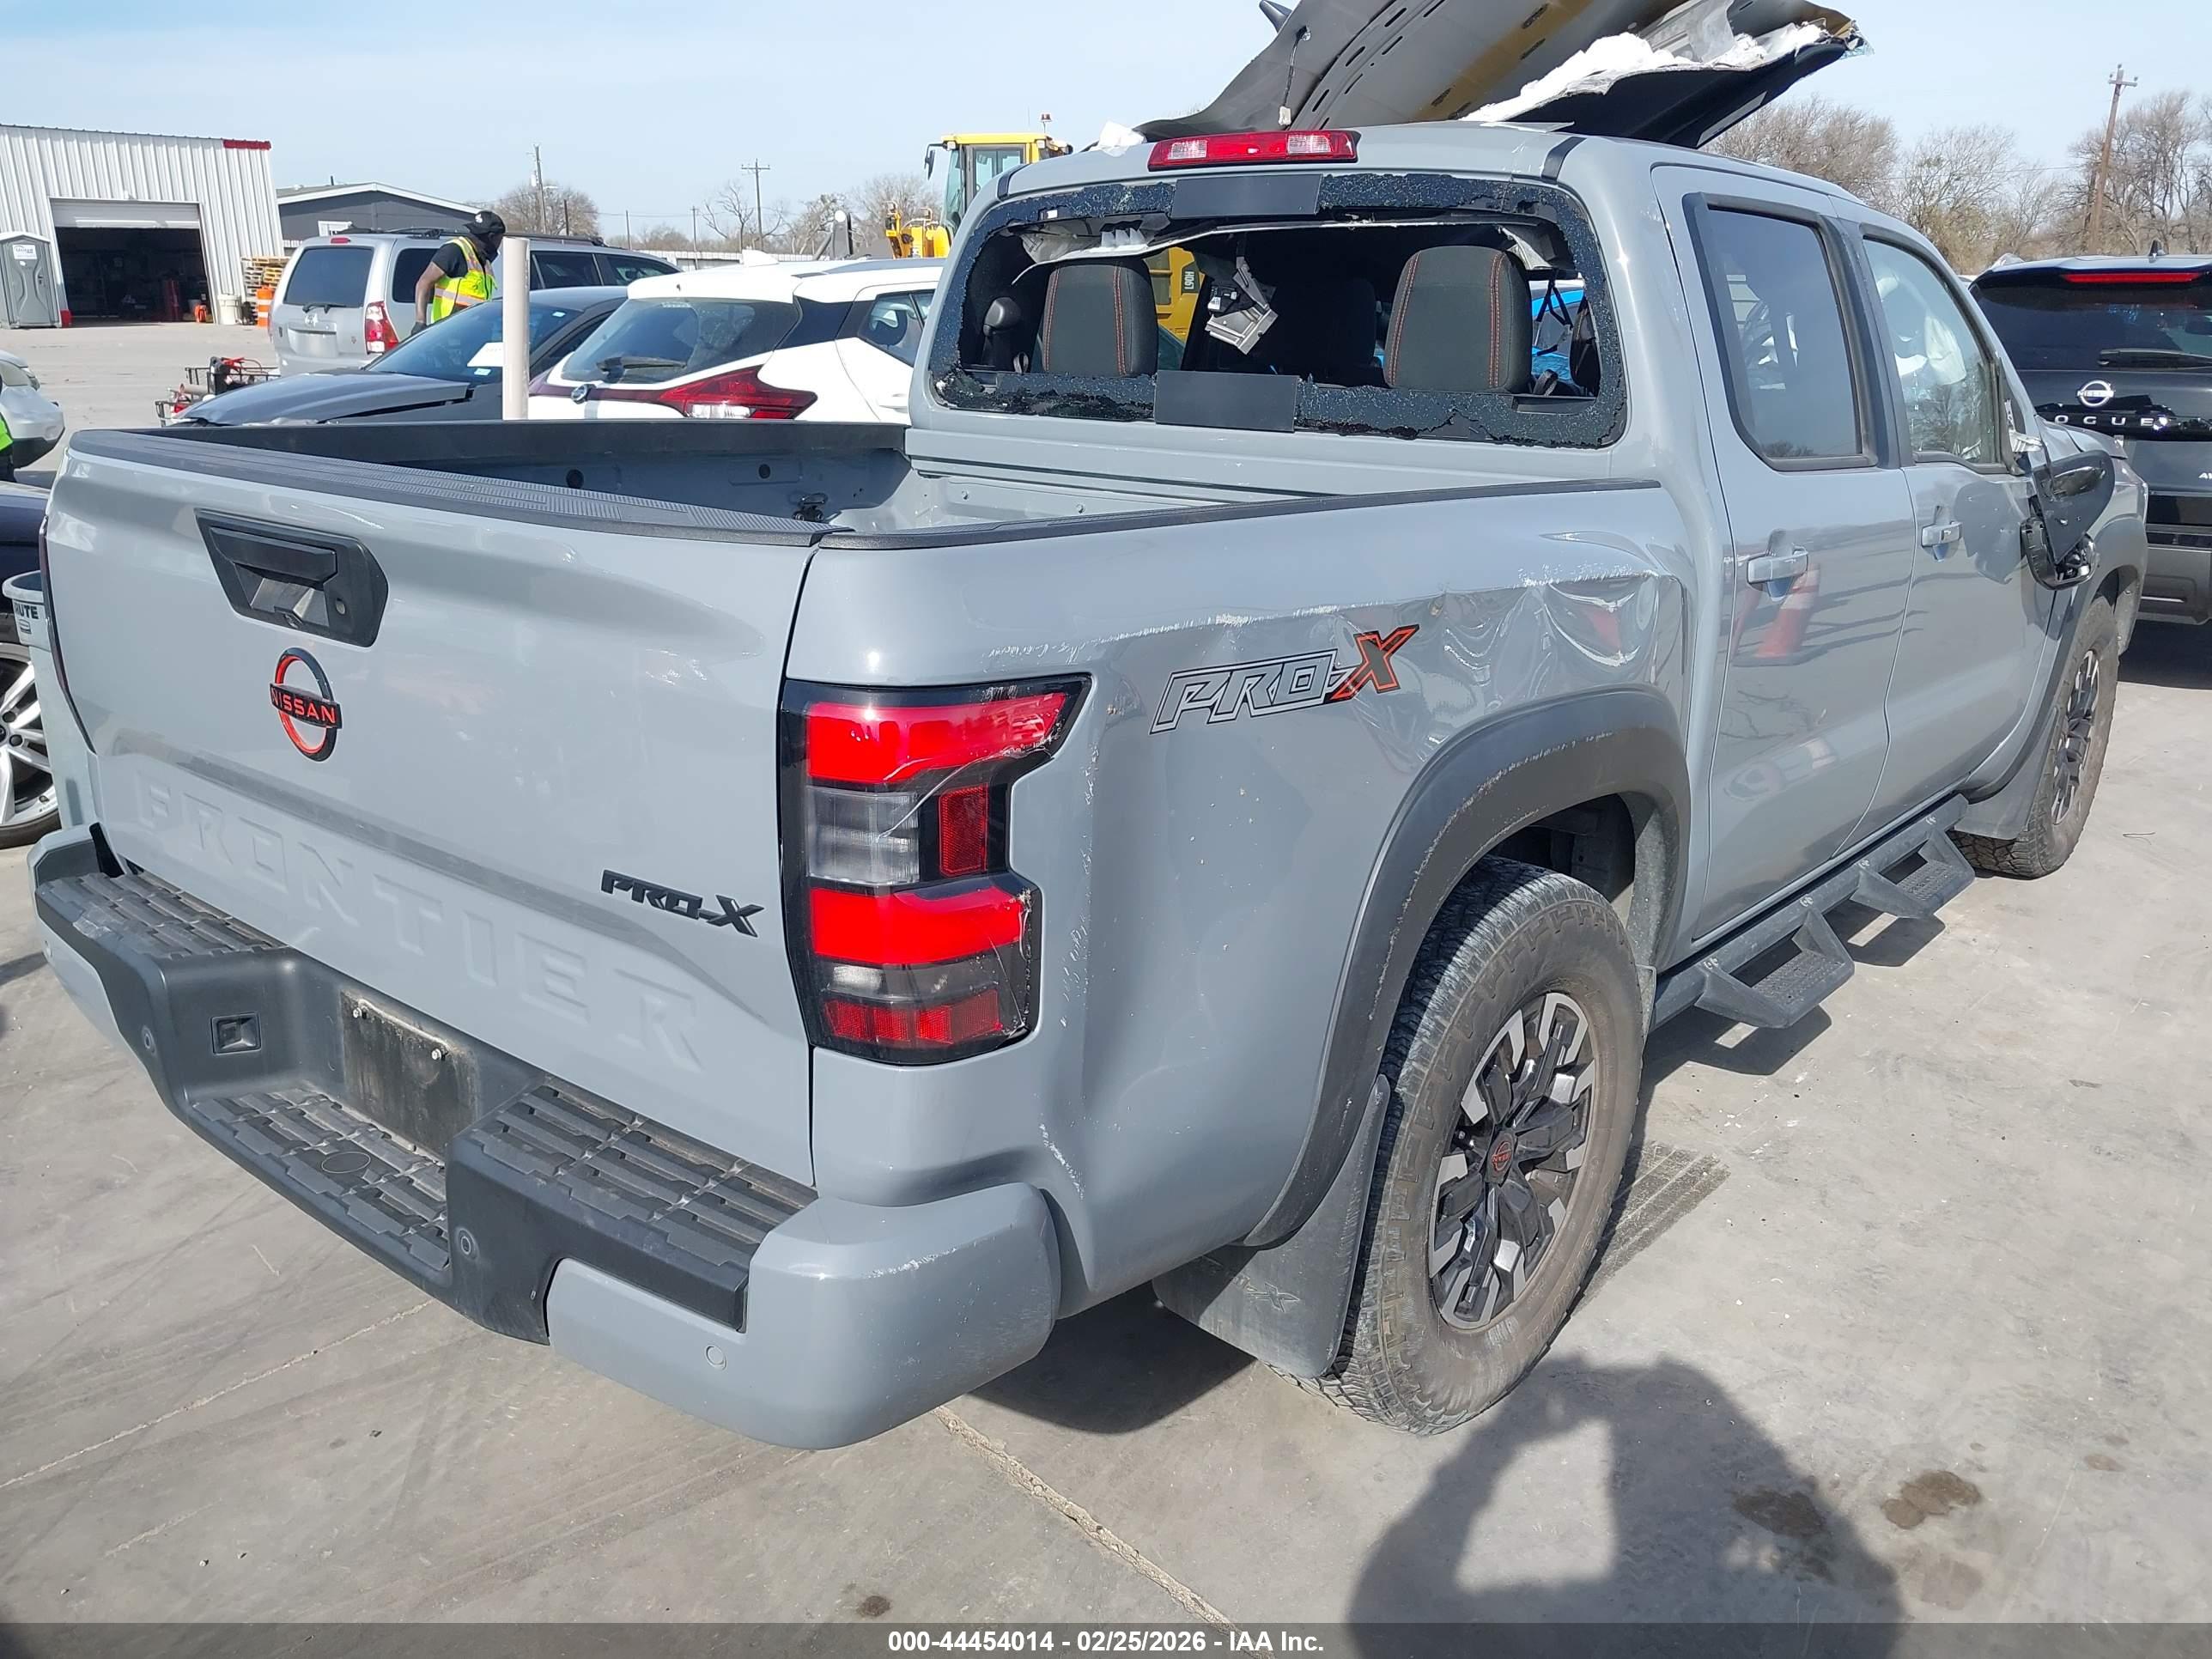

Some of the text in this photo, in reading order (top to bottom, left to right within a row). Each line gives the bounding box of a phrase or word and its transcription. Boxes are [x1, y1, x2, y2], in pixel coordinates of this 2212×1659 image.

[1184, 270, 1194, 290] L90H
[2054, 415, 2154, 427] OGUE
[270, 686, 336, 724] NISSAN
[600, 869, 765, 938] PRO-X
[135, 775, 709, 1073] FRONTIER
